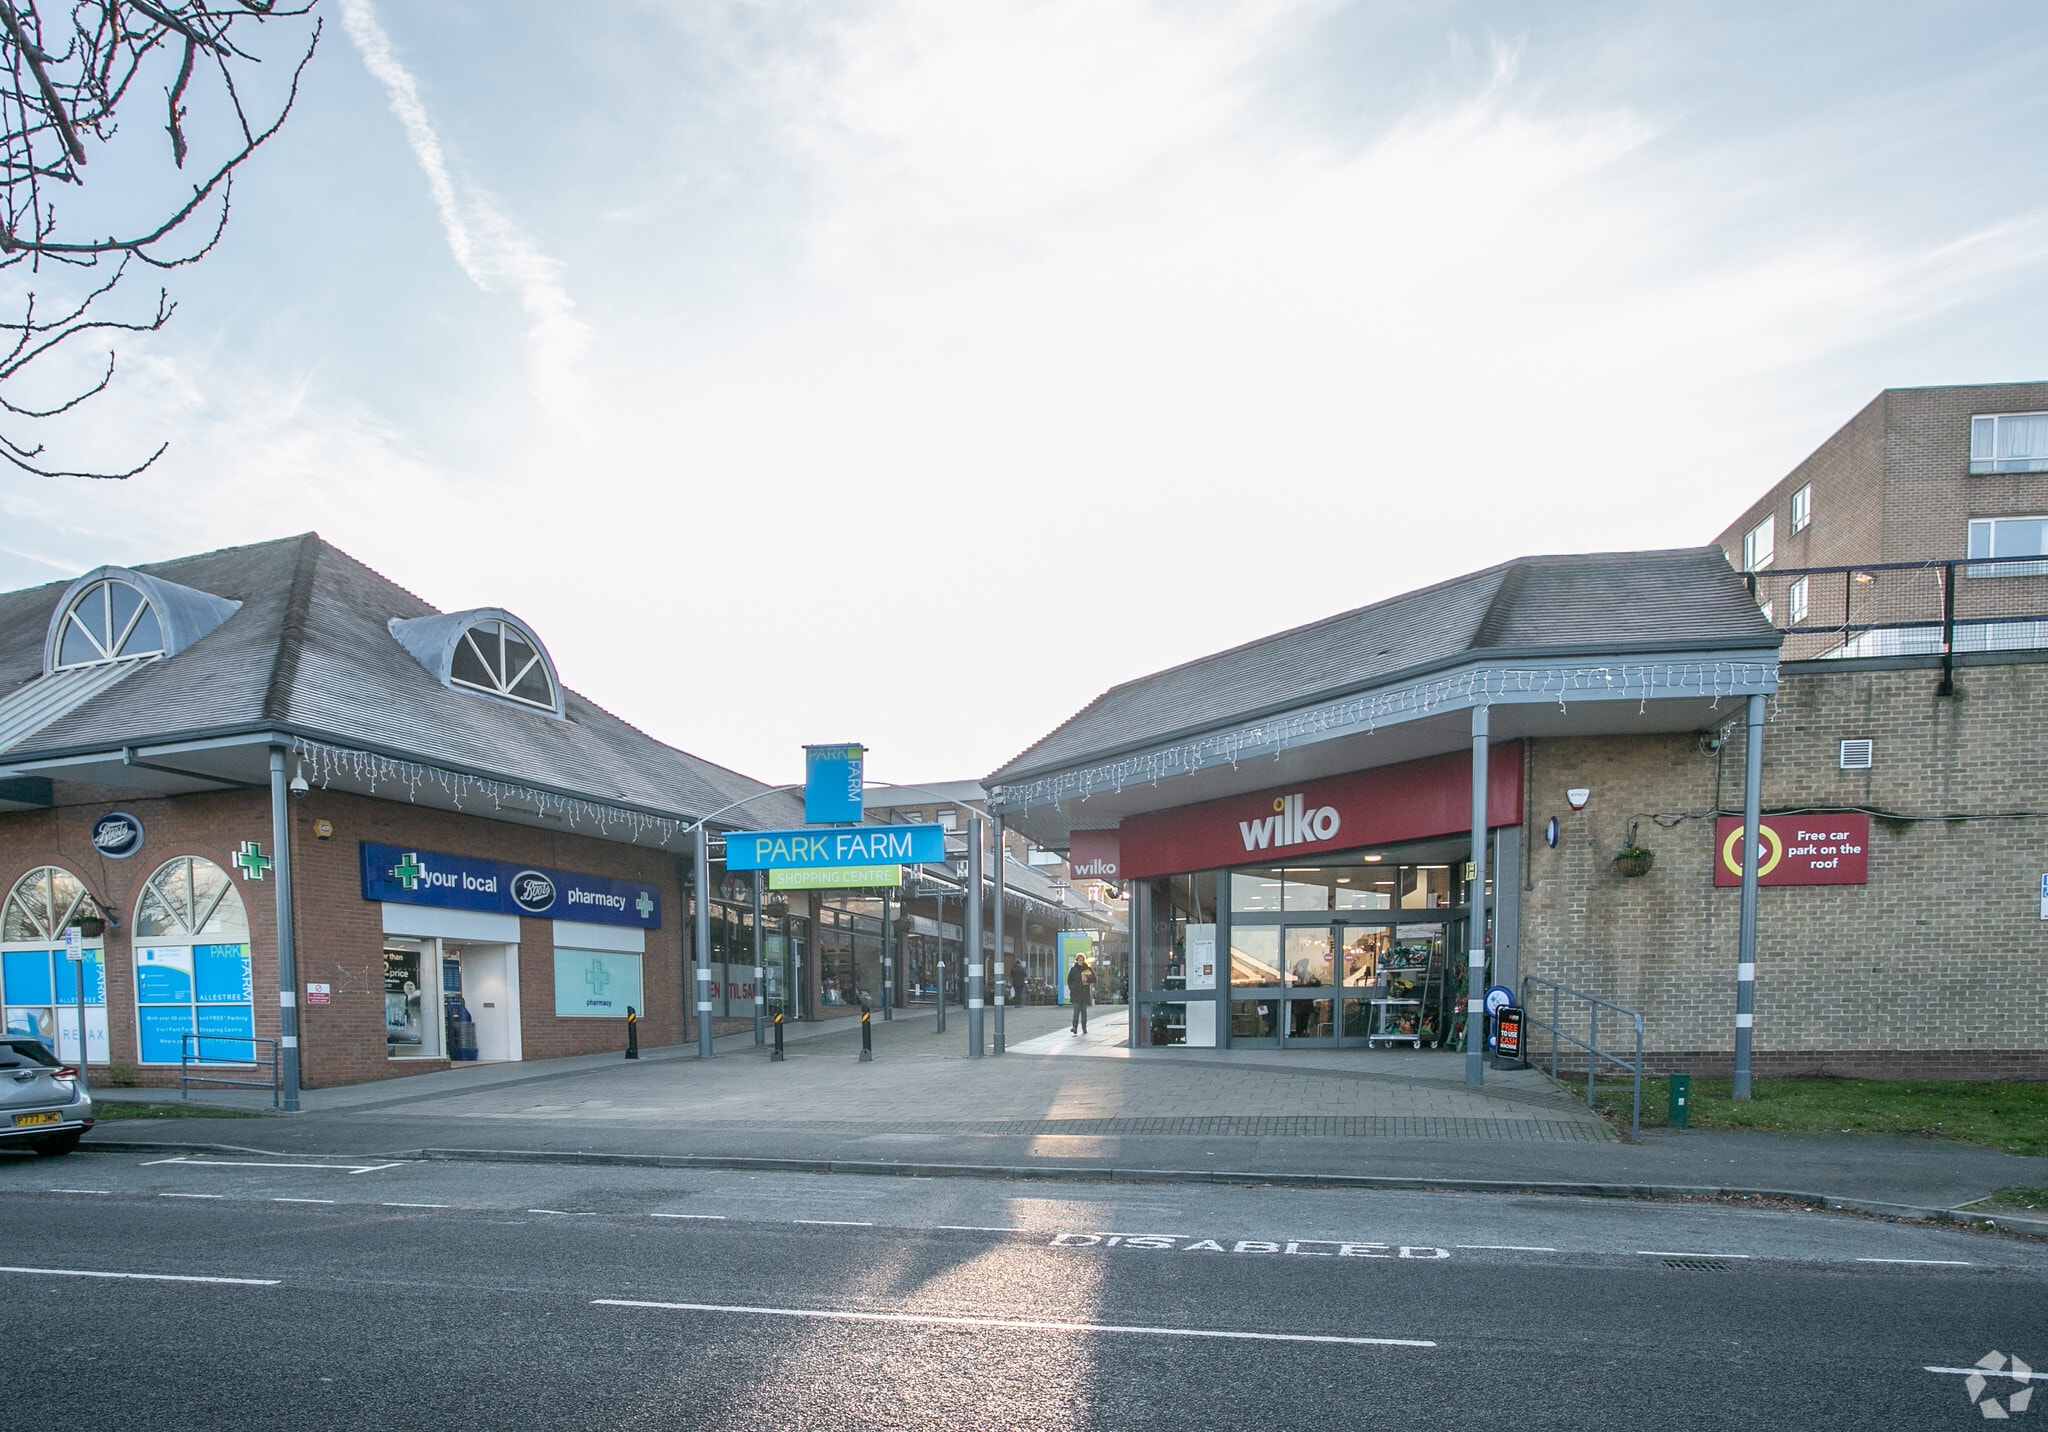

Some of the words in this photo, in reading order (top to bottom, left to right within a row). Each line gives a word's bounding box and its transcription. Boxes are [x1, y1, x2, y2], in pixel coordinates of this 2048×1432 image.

[808, 747, 848, 761] PARK
[848, 760, 861, 802] FARM
[1239, 793, 1341, 852] wilko
[95, 820, 130, 847] Boots
[1797, 830, 1827, 841] Free
[1829, 832, 1850, 840] car
[755, 835, 830, 863] PARK
[836, 832, 913, 860] FARM
[1788, 844, 1818, 858] park
[1820, 846, 1837, 855] on
[1840, 843, 1862, 854] the
[1074, 858, 1117, 875] wilko
[1810, 857, 1839, 869] roof
[777, 871, 840, 885] SHOPPING
[843, 869, 892, 882] CENTRE
[424, 870, 458, 889] your
[462, 871, 497, 893] local
[520, 879, 551, 902] Boots
[567, 887, 626, 912] pharmacy
[210, 945, 241, 959] PARK
[241, 958, 251, 1001] FARM
[389, 969, 409, 978] price
[199, 993, 242, 1001] ALLESTREE
[586, 998, 612, 1008] pharmacy
[1501, 1022, 1519, 1032] FREE
[63, 1029, 104, 1040] REAX
[1500, 1036, 1517, 1045] CASH
[17, 1114, 40, 1125] P777
[1049, 1233, 1450, 1259] DISABLED
